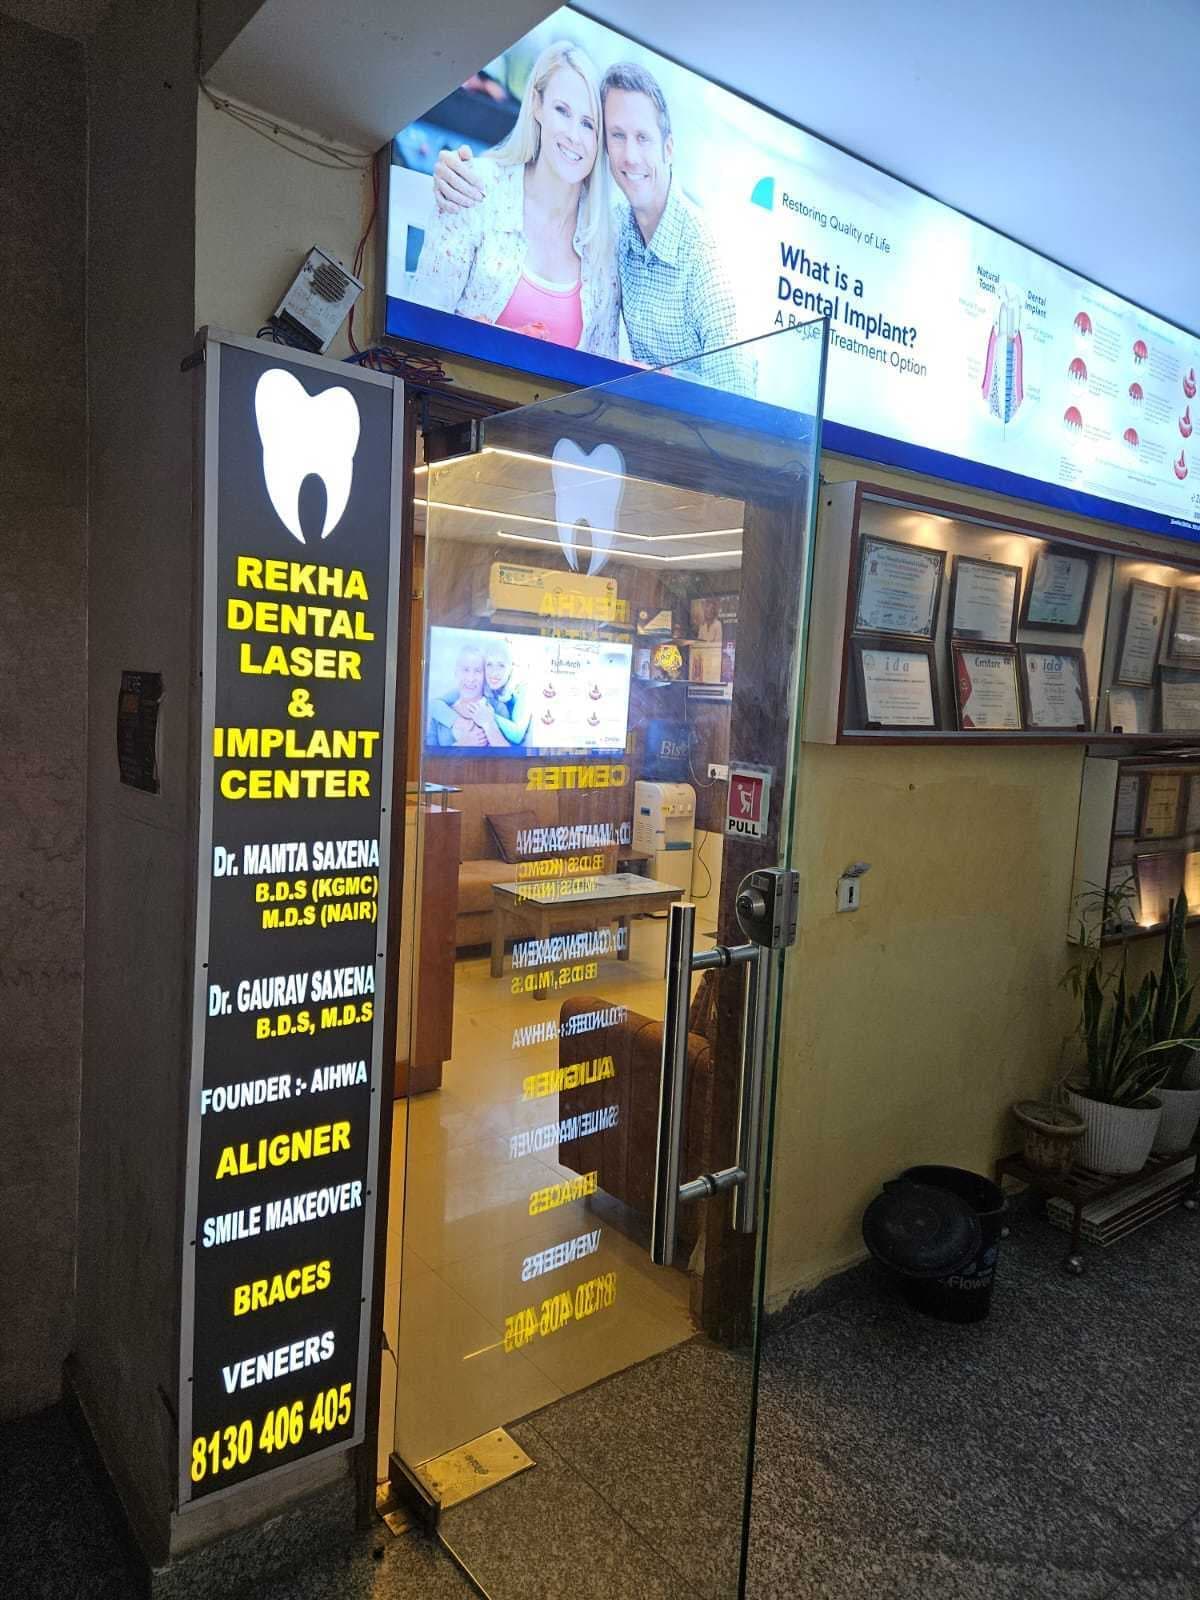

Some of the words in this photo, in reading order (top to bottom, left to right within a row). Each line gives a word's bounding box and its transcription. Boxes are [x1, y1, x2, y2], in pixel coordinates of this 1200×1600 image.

[782, 193, 827, 228] Restoring
[829, 216, 862, 244] Quality
[864, 233, 875, 245] of
[875, 236, 891, 253] Life
[780, 242, 830, 285] What
[835, 265, 848, 291] is
[853, 279, 864, 297] a
[977, 265, 1000, 283] Natural
[979, 278, 996, 294] Tooth
[777, 276, 839, 320] Dental
[844, 302, 917, 348] Implant?
[1027, 290, 1047, 306] Dental
[774, 310, 785, 327] A
[829, 328, 887, 363] Treatment
[890, 351, 927, 376] Option
[236, 555, 369, 600] REKHA
[227, 598, 375, 641] DENTAL
[239, 642, 362, 680] LASER
[287, 688, 315, 718] &
[213, 726, 379, 759] IMPLANT
[220, 768, 371, 800] CENTER
[728, 818, 760, 836] PULL
[213, 846, 239, 877] Dr.
[243, 842, 309, 875] MAMTA
[312, 839, 379, 871] SAXENA
[255, 880, 307, 902] B.D.S
[312, 875, 378, 903] (KGMC)
[262, 905, 316, 929] M.D.S
[320, 901, 378, 928] (NAIR)
[208, 984, 232, 1016] Dr.
[237, 973, 309, 1013] GAURAV
[311, 965, 375, 1002] SAXENA
[256, 1011, 315, 1039] B.D.S,
[320, 1002, 373, 1029] M.D.S
[200, 1074, 291, 1115] FOUNDER
[310, 1060, 368, 1093] AIHWA
[215, 1121, 351, 1180] ALIGNER
[202, 1206, 261, 1248] SMILE
[265, 1180, 362, 1231] MAKEOVER
[233, 1260, 331, 1316] BRACES
[222, 1331, 335, 1394] VENEERS
[190, 1419, 253, 1482] 8130
[259, 1400, 304, 1454] 406
[309, 1382, 352, 1434] 405
